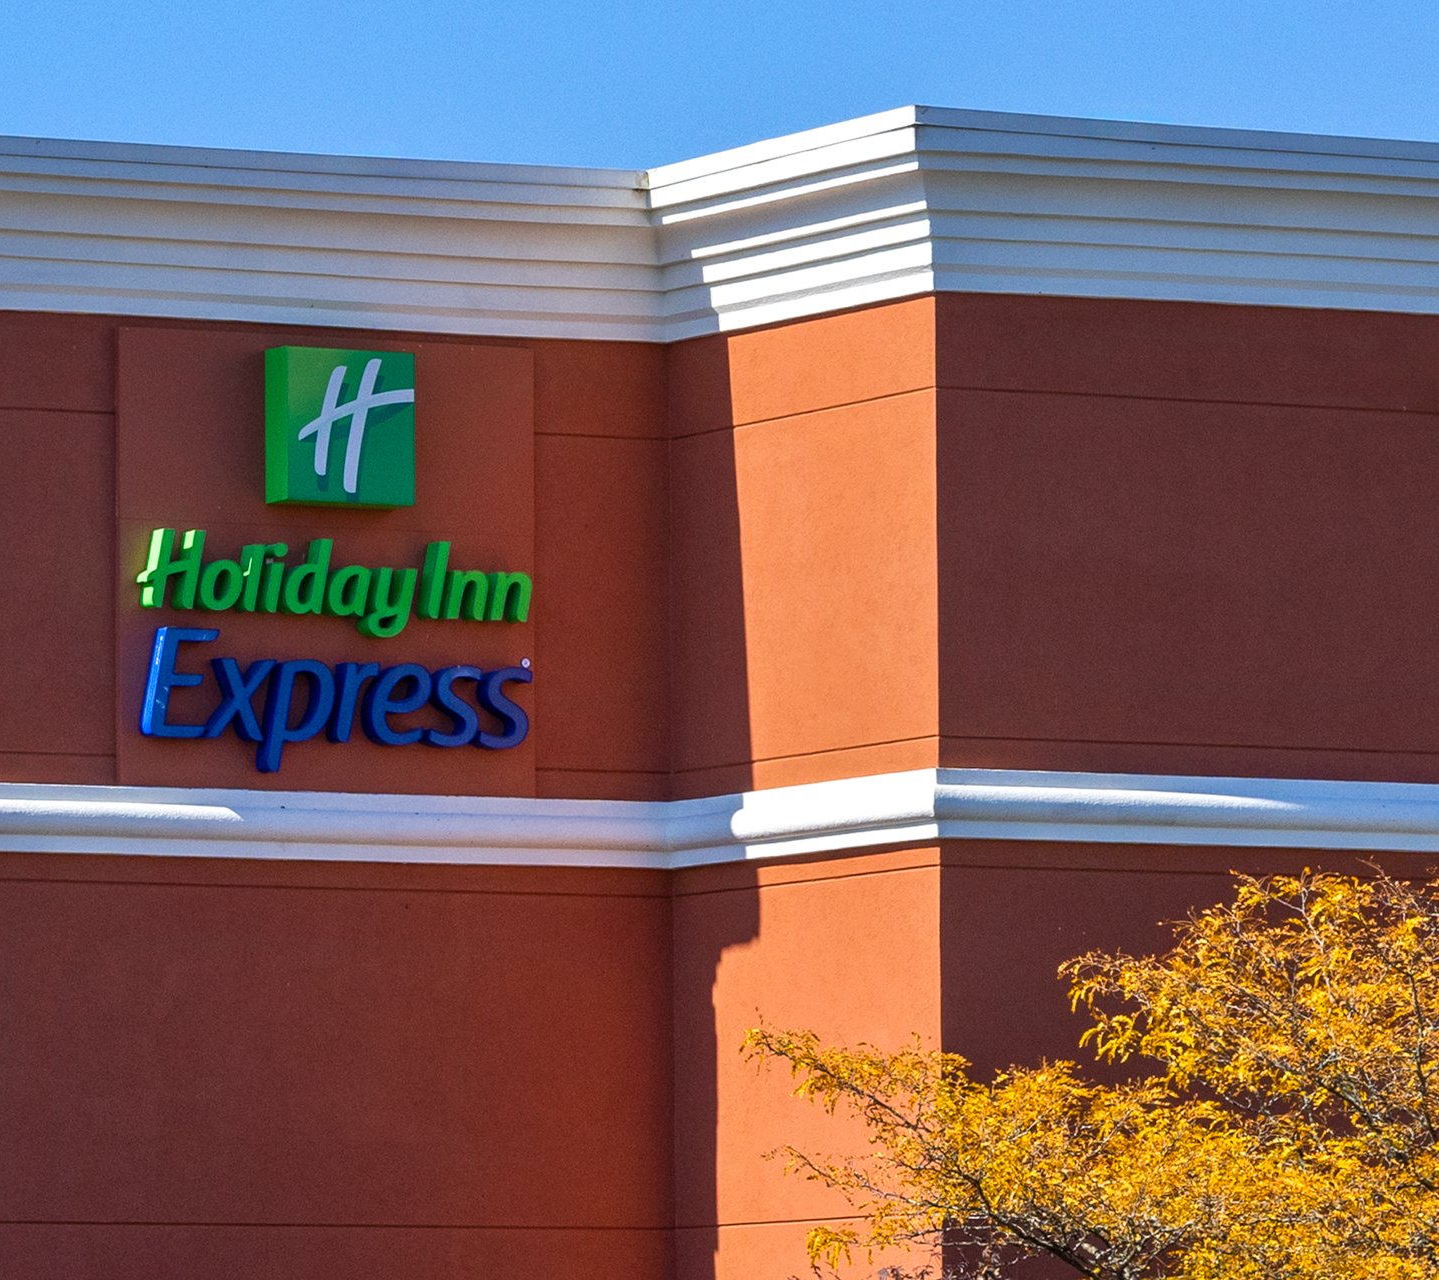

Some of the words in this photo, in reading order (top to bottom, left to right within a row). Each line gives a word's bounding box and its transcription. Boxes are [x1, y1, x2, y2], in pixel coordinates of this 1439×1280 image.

[298, 358, 415, 493] H
[136, 528, 417, 637] Holiday
[418, 541, 533, 622] Inn
[139, 626, 533, 773] Express
